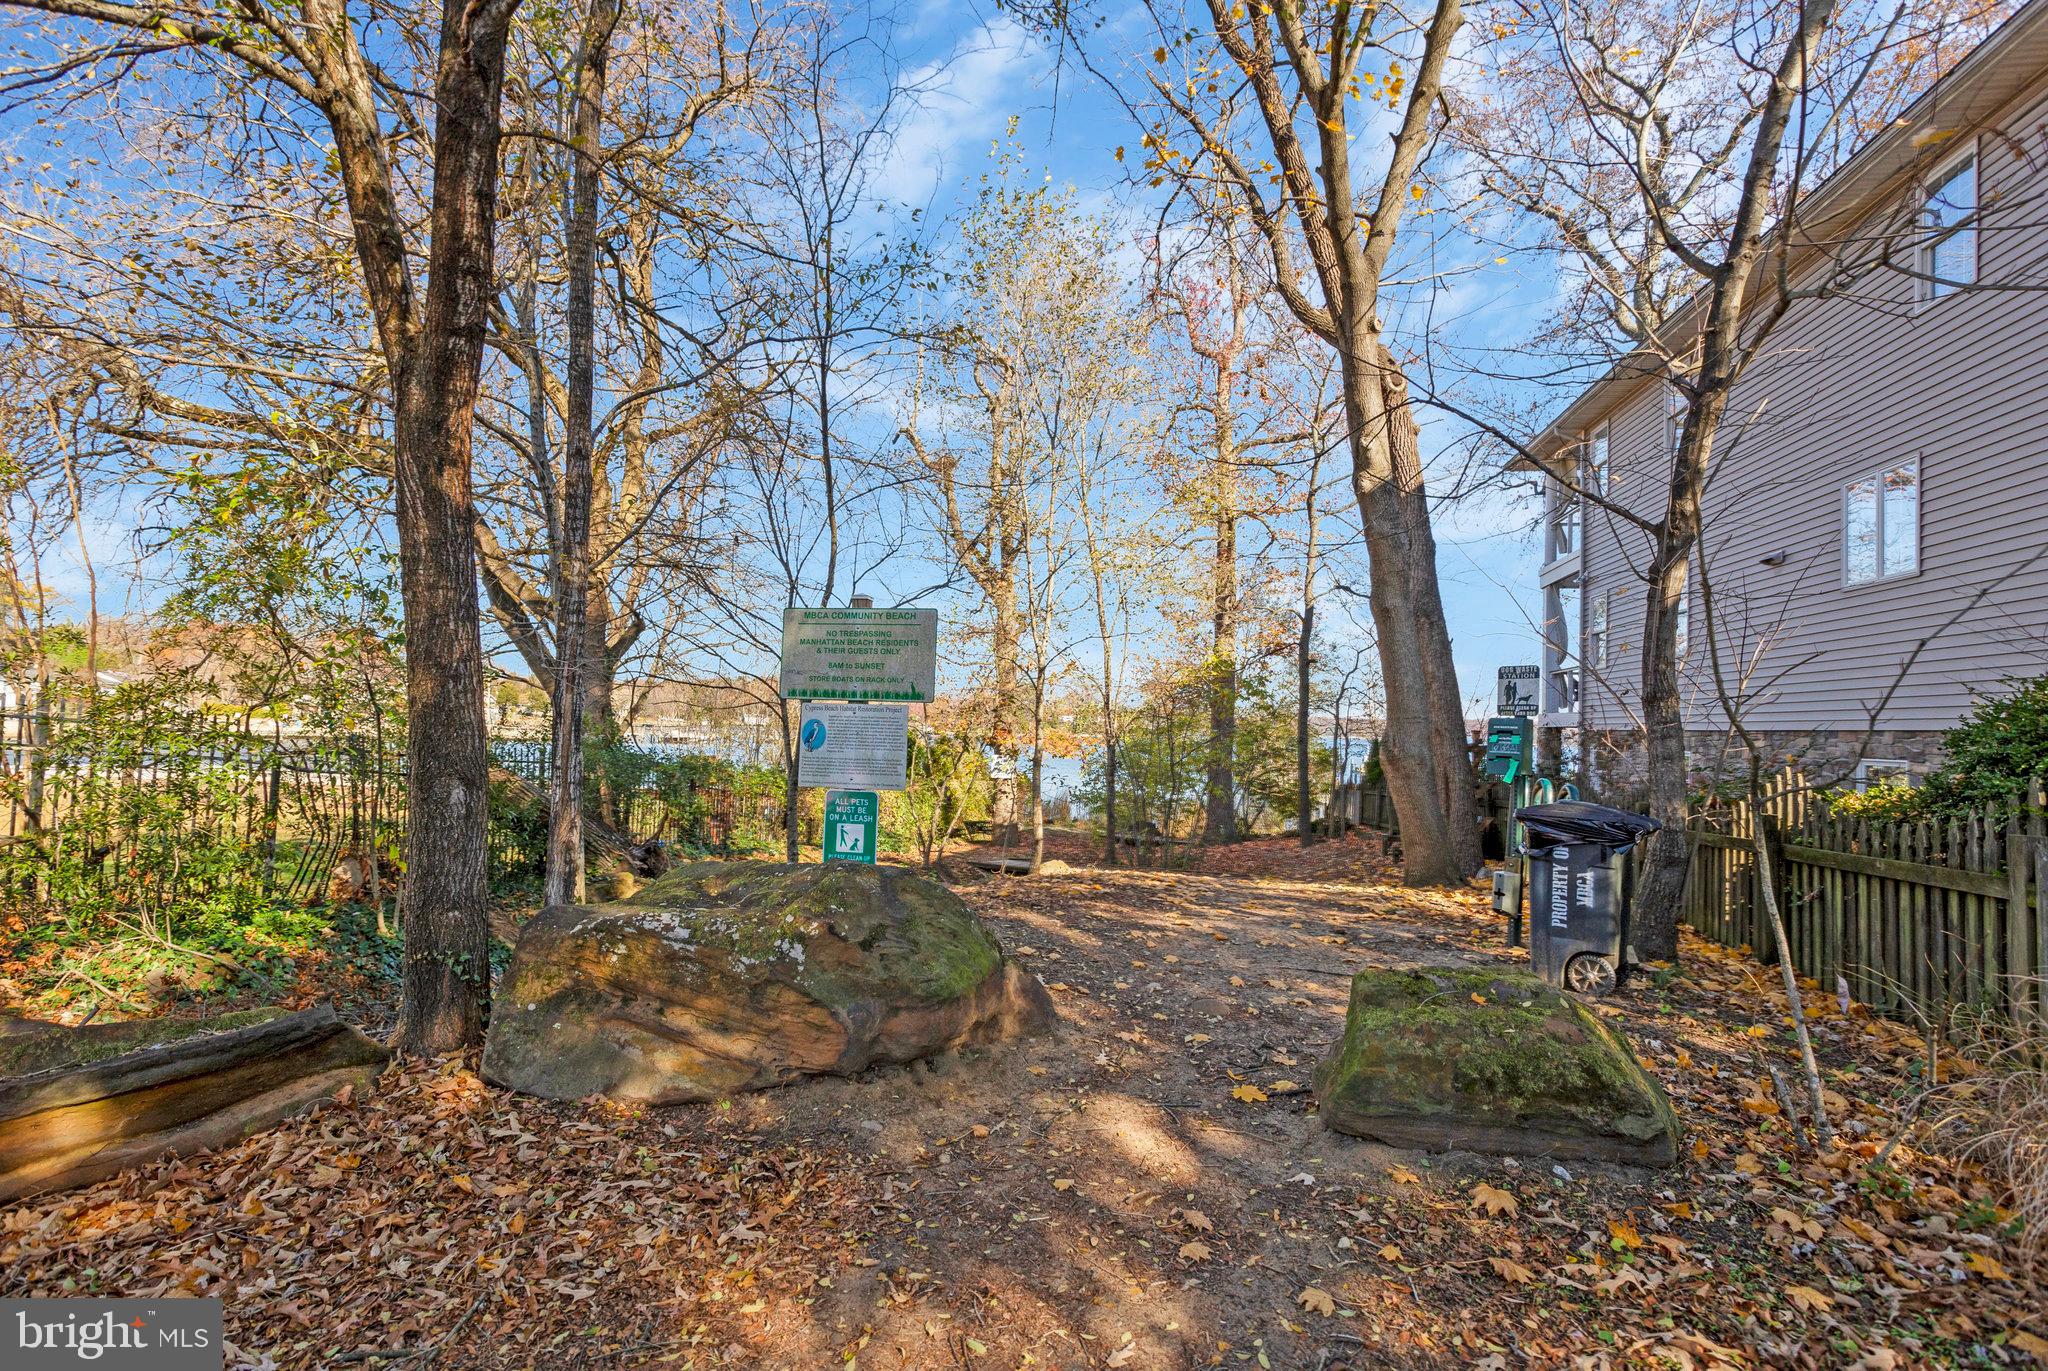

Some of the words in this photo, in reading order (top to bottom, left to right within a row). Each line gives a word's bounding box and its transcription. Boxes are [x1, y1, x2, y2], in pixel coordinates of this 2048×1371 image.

[804, 611, 829, 619] MBCA
[832, 612, 883, 620] COMMUNITY
[886, 612, 916, 620] BEACH
[804, 704, 824, 712] Cypress
[850, 814, 872, 822] LEASH
[1576, 870, 1594, 908] MBCA
[1552, 862, 1568, 929] PROPERTY
